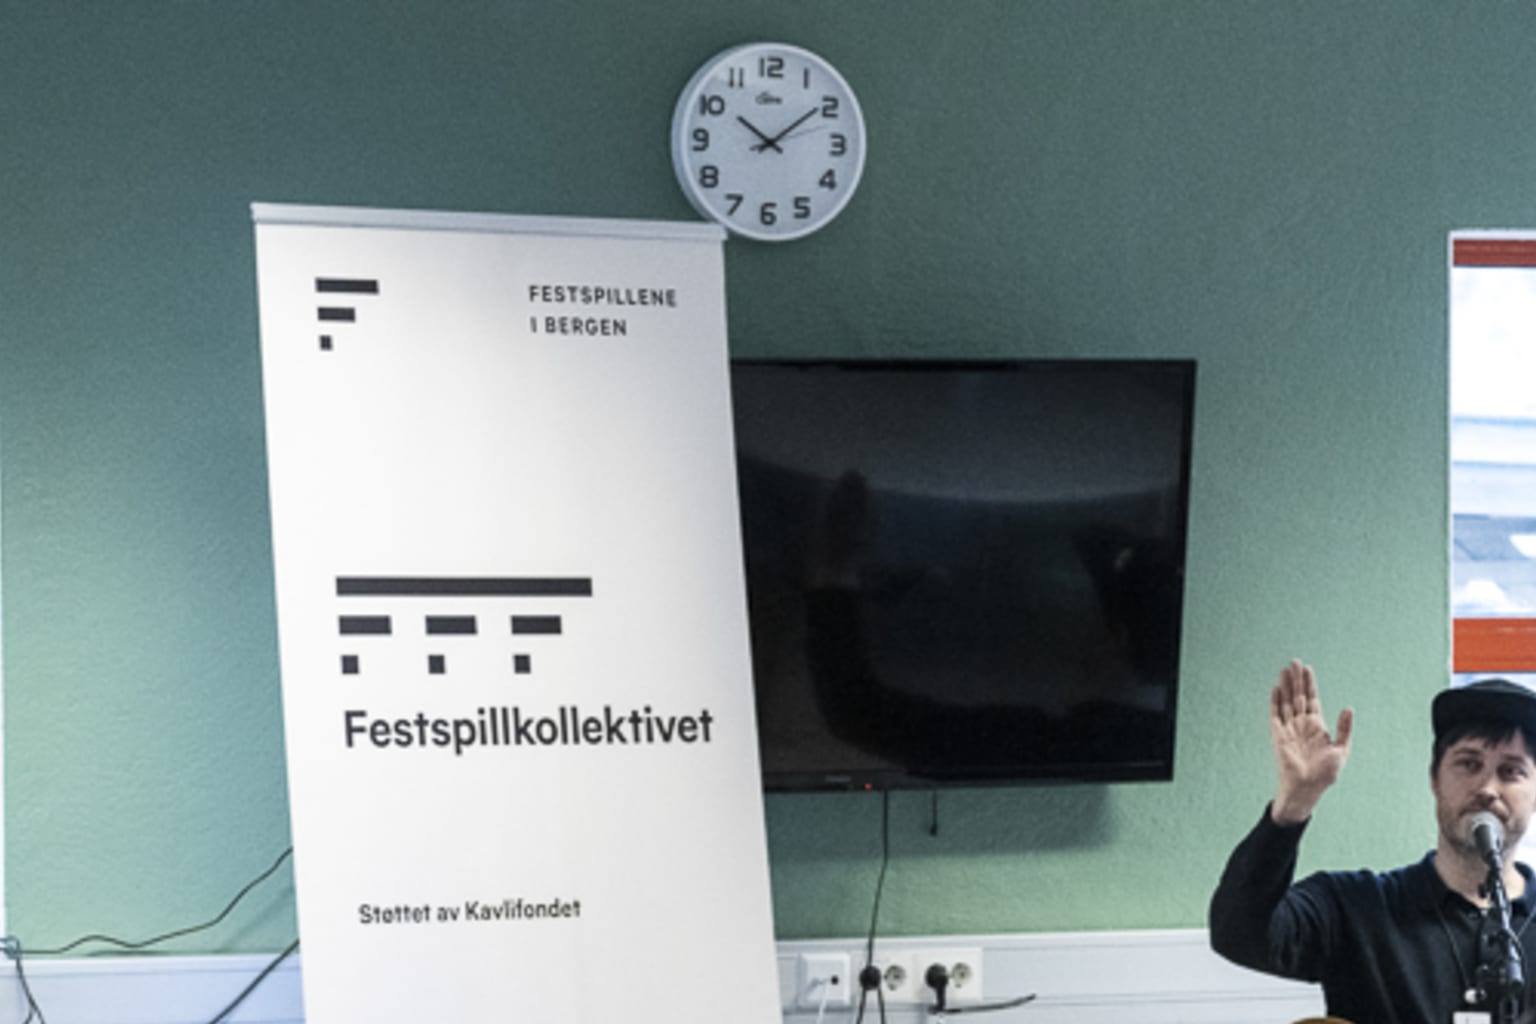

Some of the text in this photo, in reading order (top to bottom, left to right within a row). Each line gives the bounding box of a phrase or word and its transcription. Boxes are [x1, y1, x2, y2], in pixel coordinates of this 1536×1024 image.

[728, 67, 745, 89] 11
[758, 56, 785, 78] 12
[802, 67, 811, 90] 1
[699, 94, 726, 117] 10
[821, 96, 840, 119] 2
[691, 128, 711, 153] 9
[828, 132, 848, 158] 3
[699, 164, 720, 190] 8
[818, 168, 838, 191] 4
[724, 193, 745, 217] 7
[759, 201, 778, 227] 6
[792, 195, 811, 220] 5
[528, 284, 677, 307] FESTSPILLENE
[530, 315, 627, 336] I BERGEN
[343, 704, 713, 756] Festspillkollektivet
[436, 906, 461, 923] av
[464, 898, 582, 922] Kavlifondet
